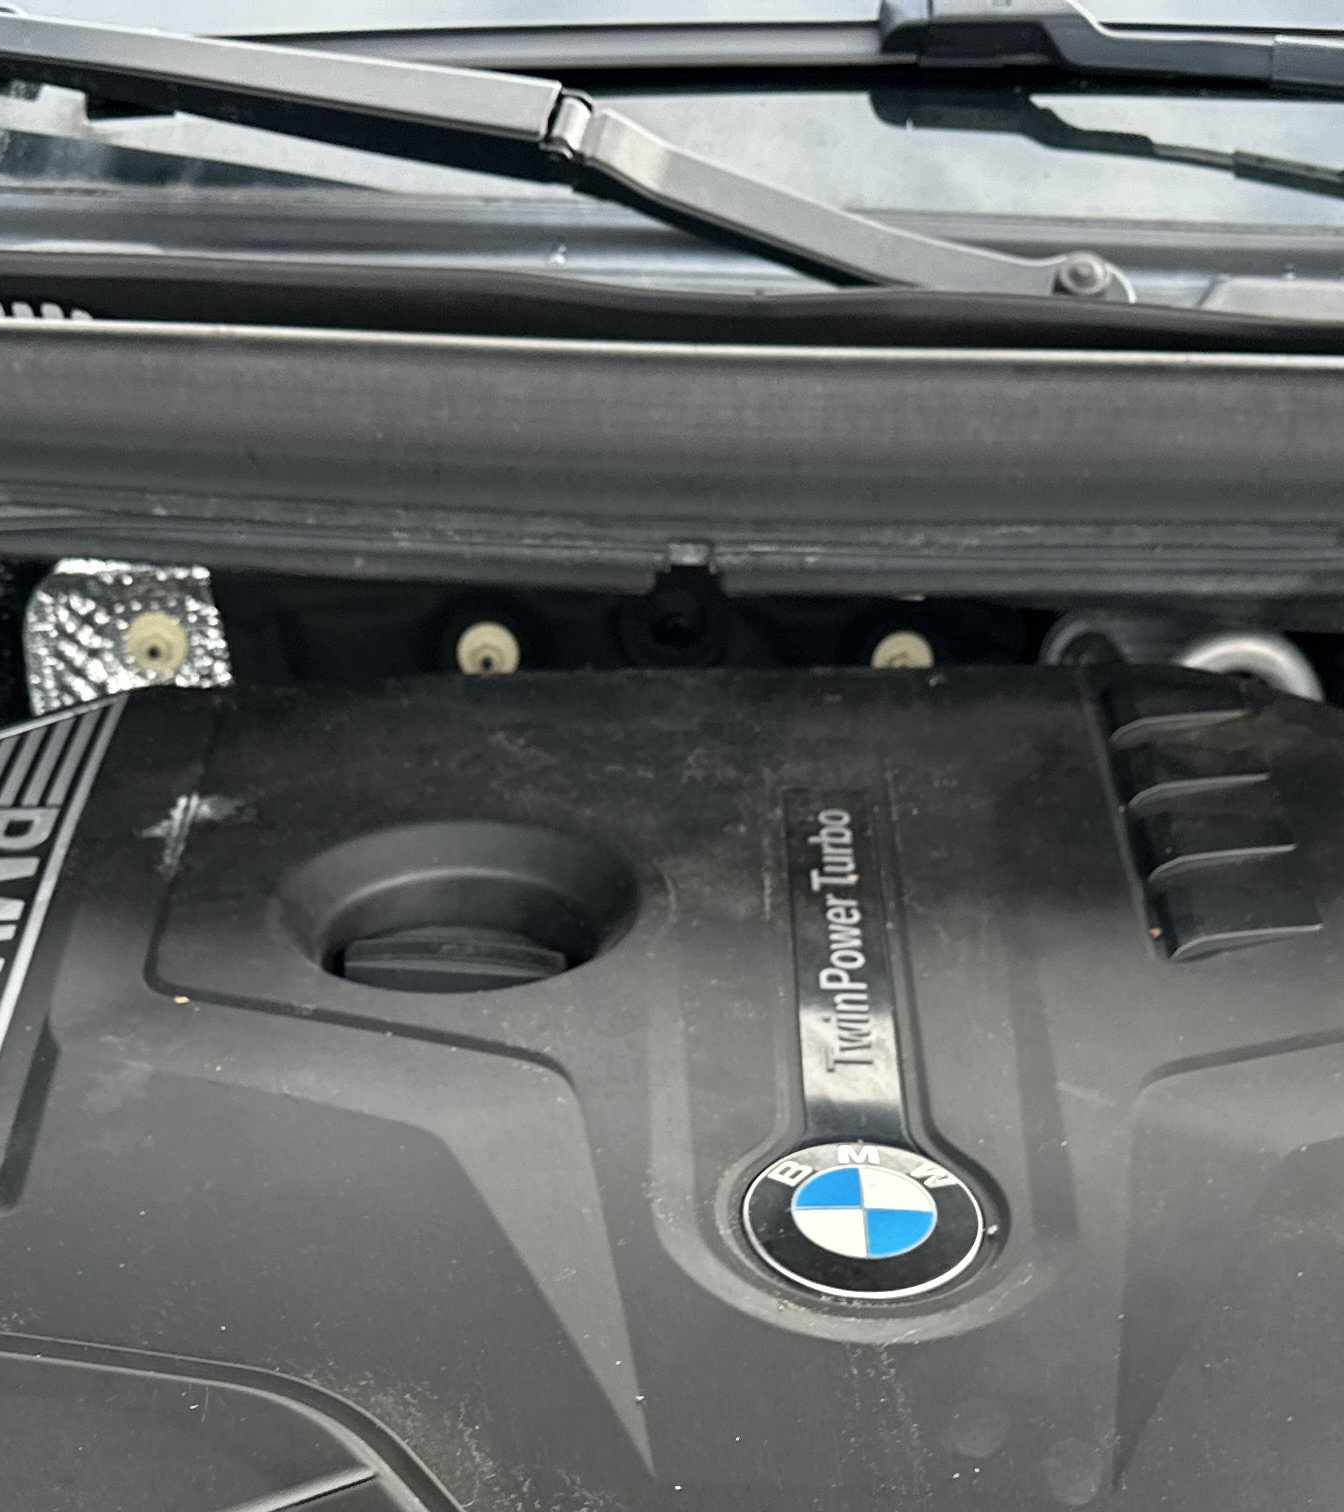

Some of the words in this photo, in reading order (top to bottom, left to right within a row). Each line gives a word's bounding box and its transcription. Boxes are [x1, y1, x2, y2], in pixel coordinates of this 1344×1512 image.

[808, 807, 859, 892] Turbo
[819, 892, 874, 1074] TwinPower
[767, 1144, 957, 1190] BMW
